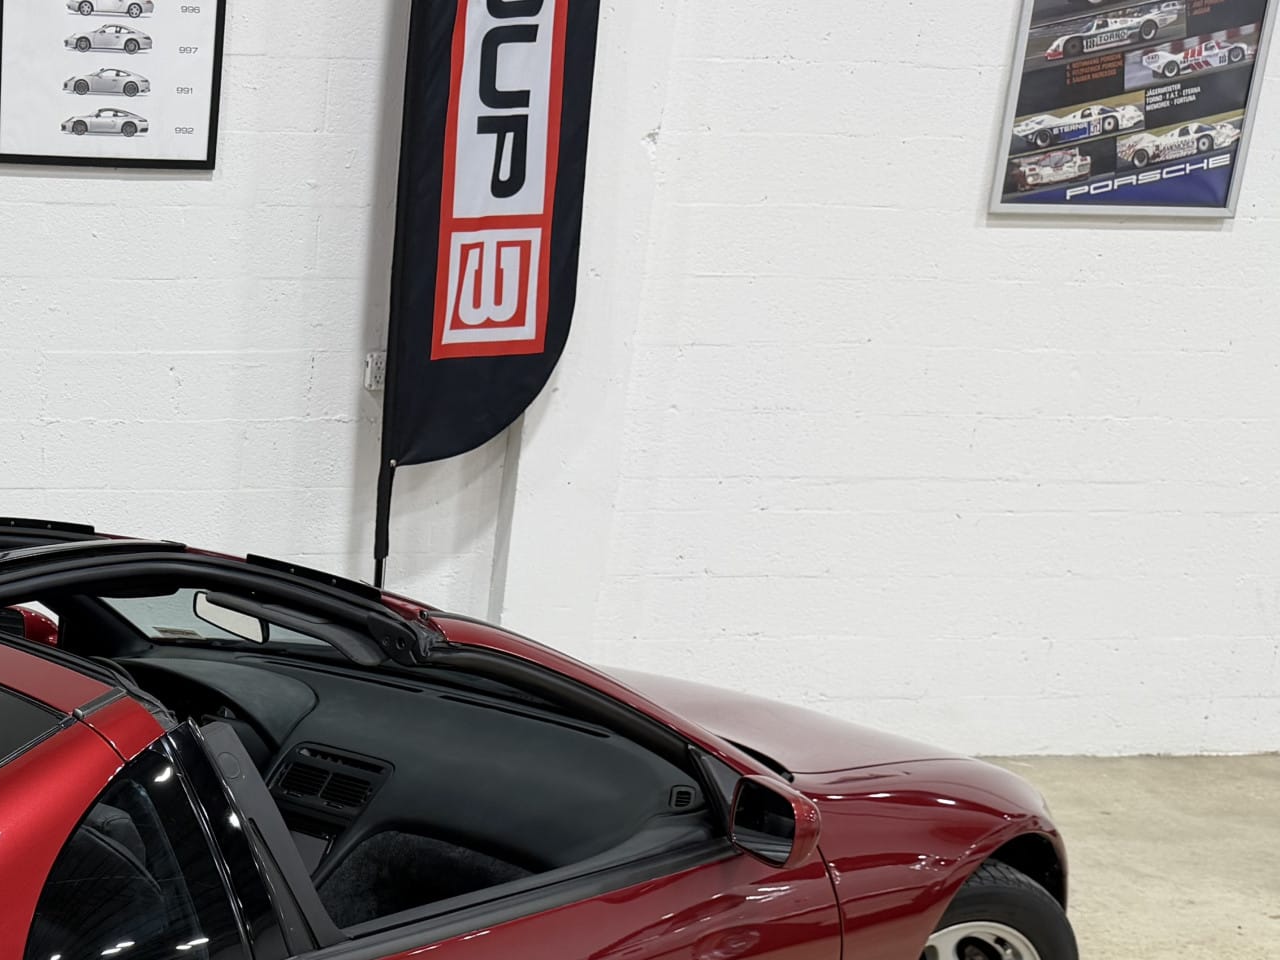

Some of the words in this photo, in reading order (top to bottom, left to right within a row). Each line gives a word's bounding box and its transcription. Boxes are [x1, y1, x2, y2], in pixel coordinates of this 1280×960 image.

[180, 5, 201, 14] 996
[179, 46, 199, 54] 997
[176, 86, 193, 95] 991
[476, 0, 539, 199] UP
[174, 126, 195, 134] 992
[1066, 154, 1231, 200] PORSCHE
